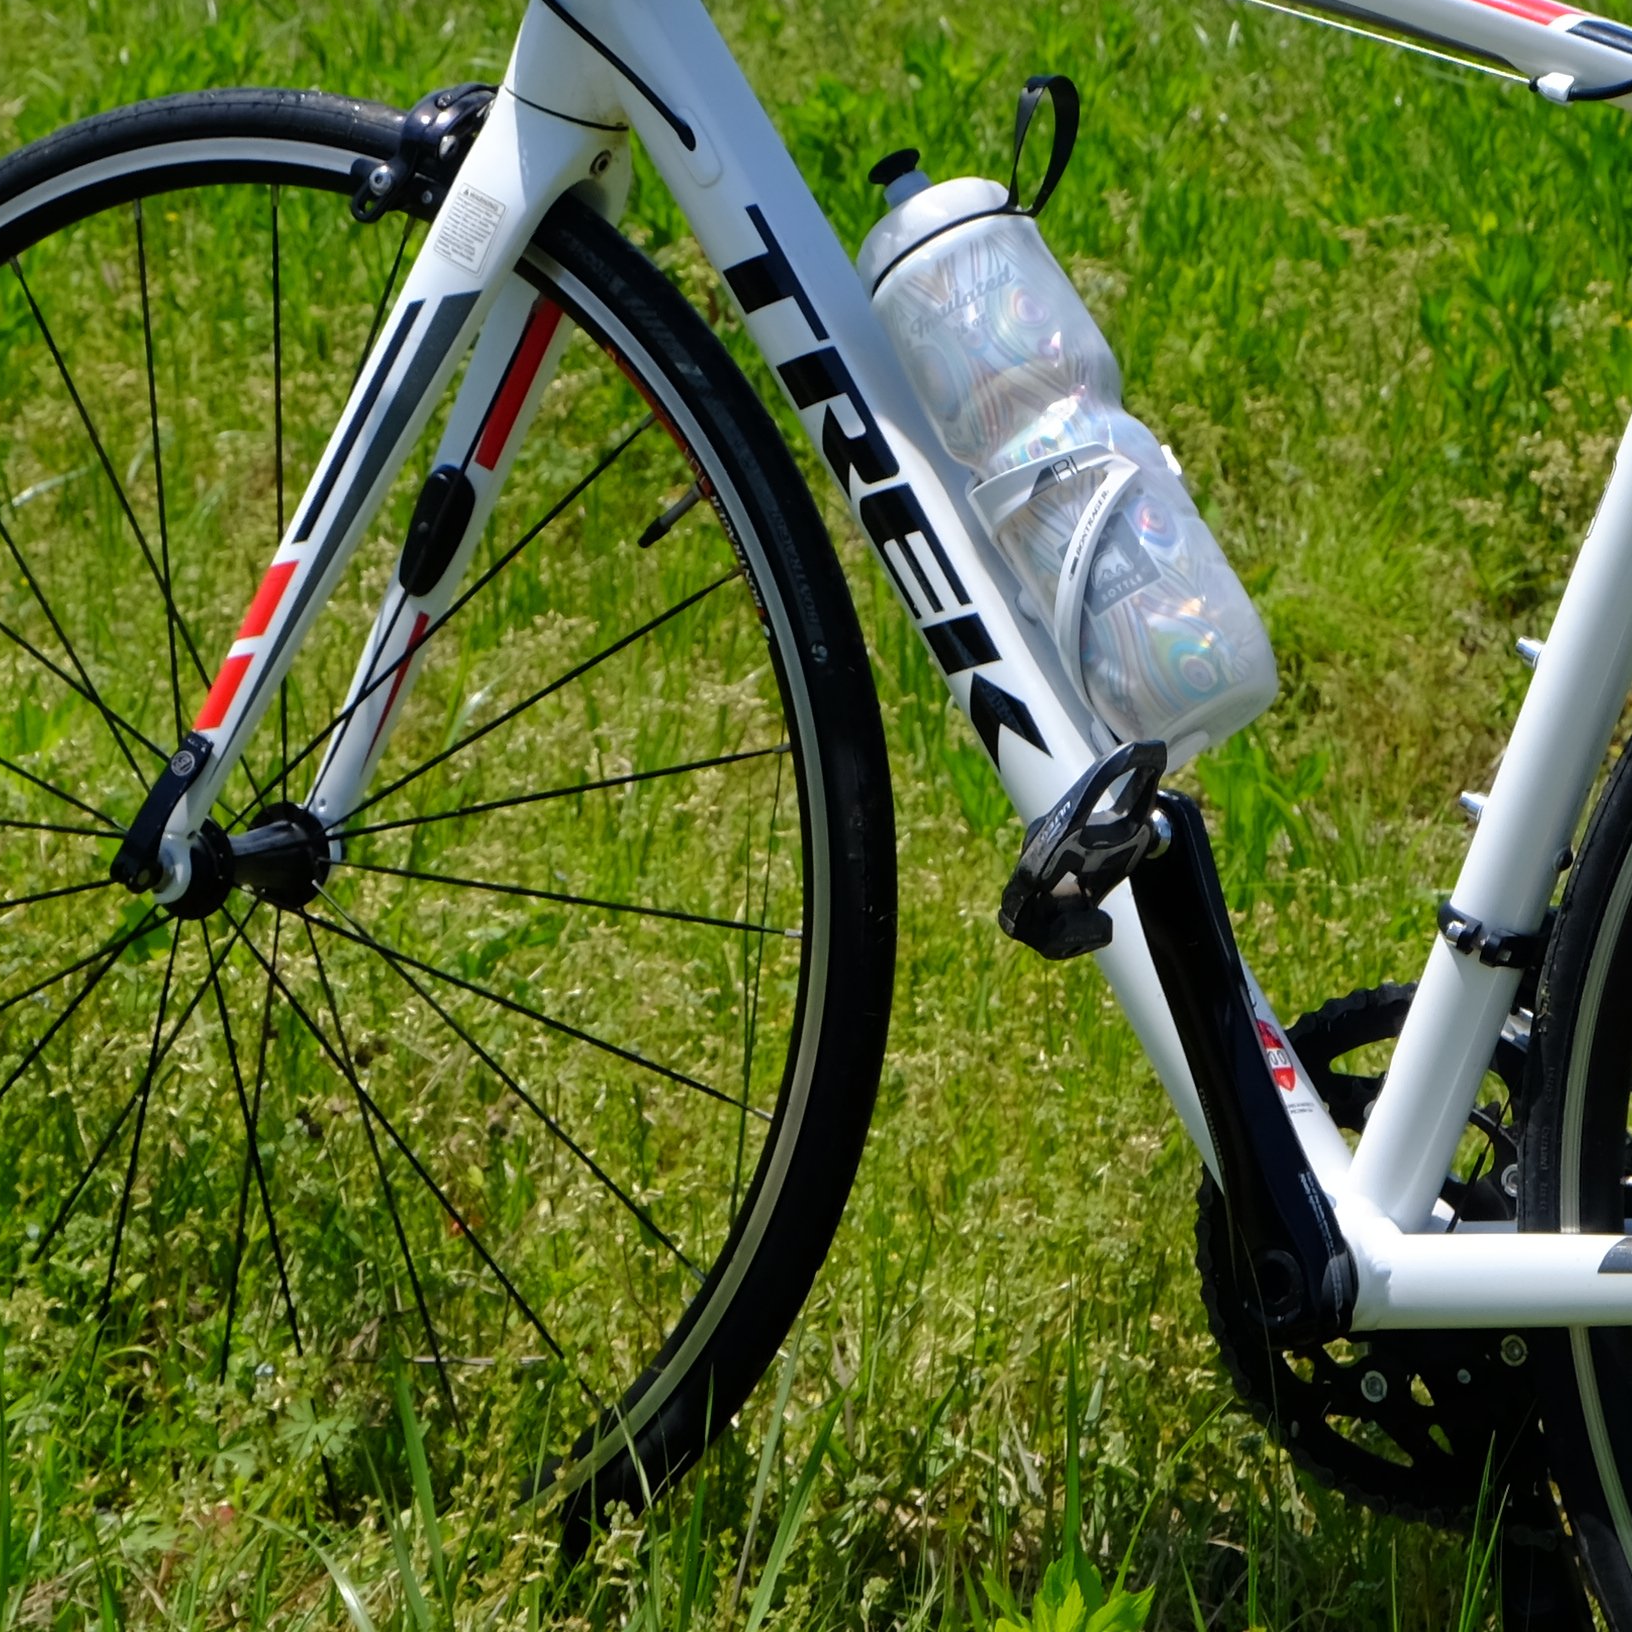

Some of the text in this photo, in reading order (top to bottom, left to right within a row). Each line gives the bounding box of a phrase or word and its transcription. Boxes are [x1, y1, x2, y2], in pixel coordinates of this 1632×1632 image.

[723, 204, 1054, 769] TREK
[1075, 490, 1110, 556] BONTRAGER
[1101, 572, 1144, 604] BOTTLE
